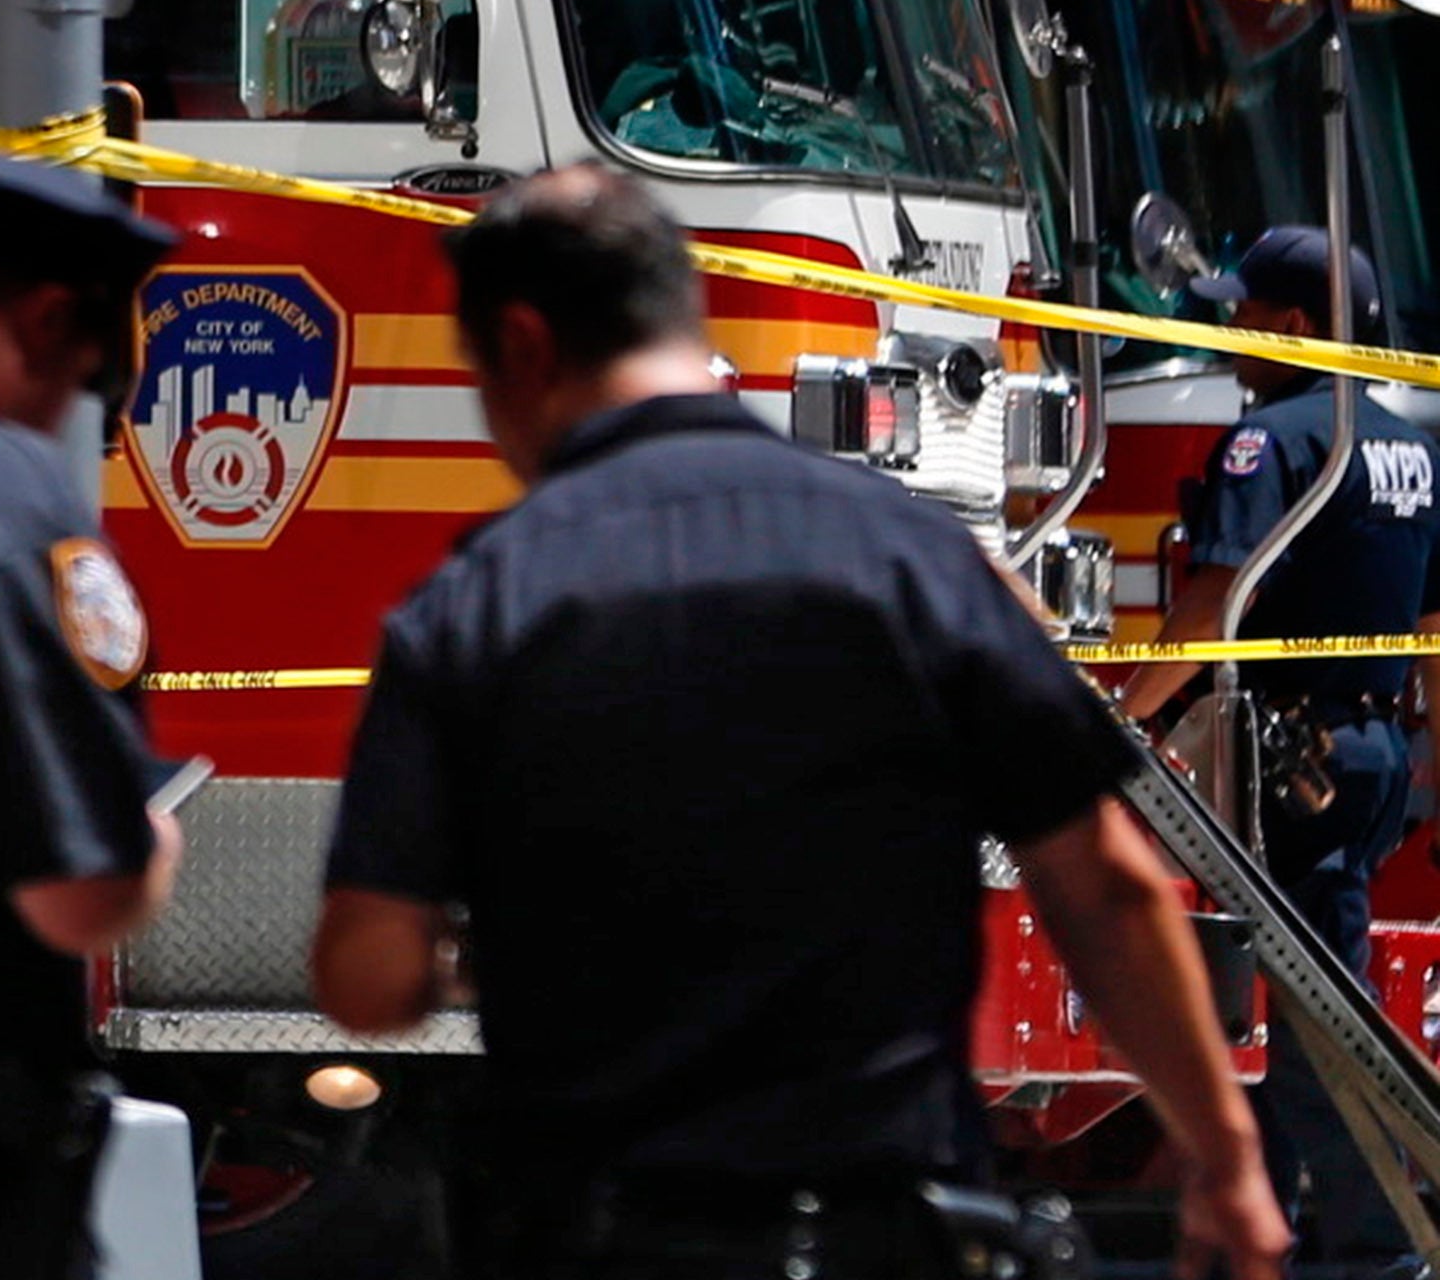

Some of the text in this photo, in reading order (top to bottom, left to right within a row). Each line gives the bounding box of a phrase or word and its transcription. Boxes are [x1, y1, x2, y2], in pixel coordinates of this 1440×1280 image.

[142, 282, 322, 346] FIRE DEPARTMENT
[196, 320, 264, 337] CITY OF
[184, 338, 275, 355] NEW YORK
[1361, 439, 1433, 492] NYPD
